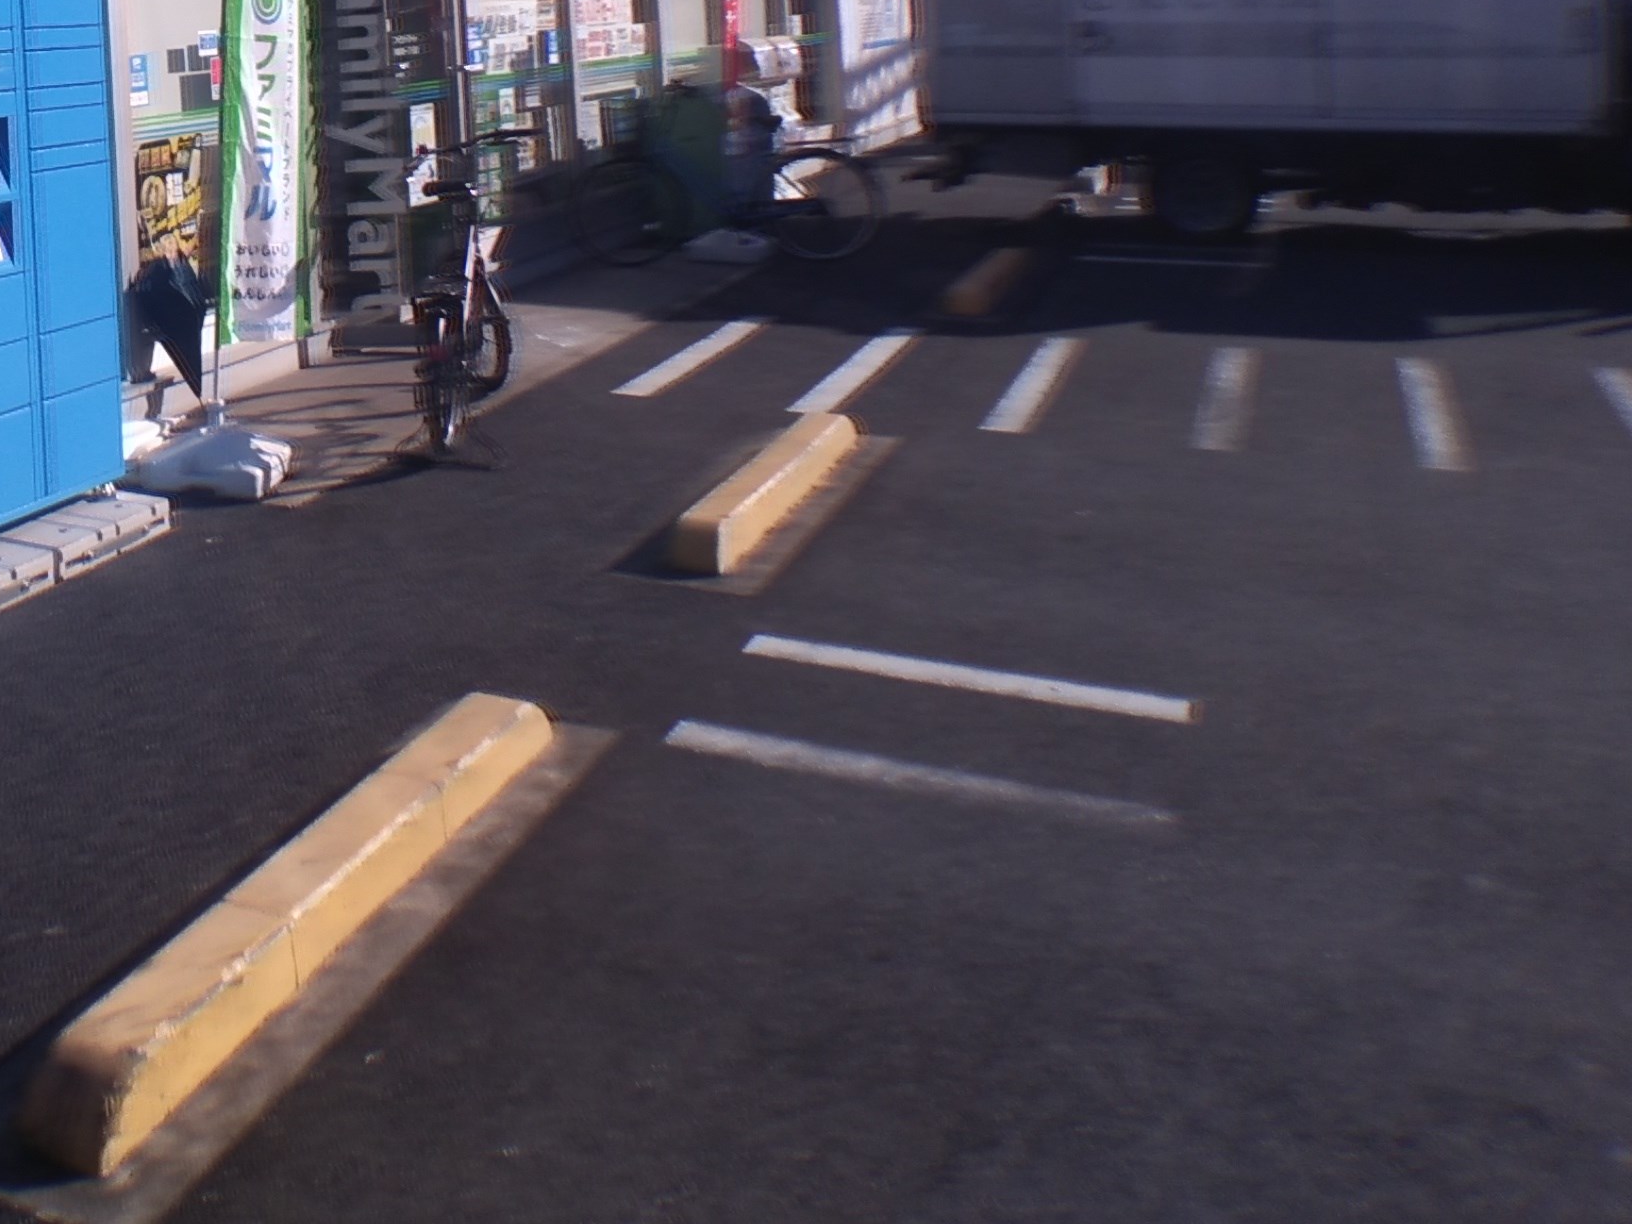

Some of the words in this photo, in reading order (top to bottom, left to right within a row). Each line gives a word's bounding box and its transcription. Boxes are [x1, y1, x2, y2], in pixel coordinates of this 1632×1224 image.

[244, 33, 279, 221] ファミマル
